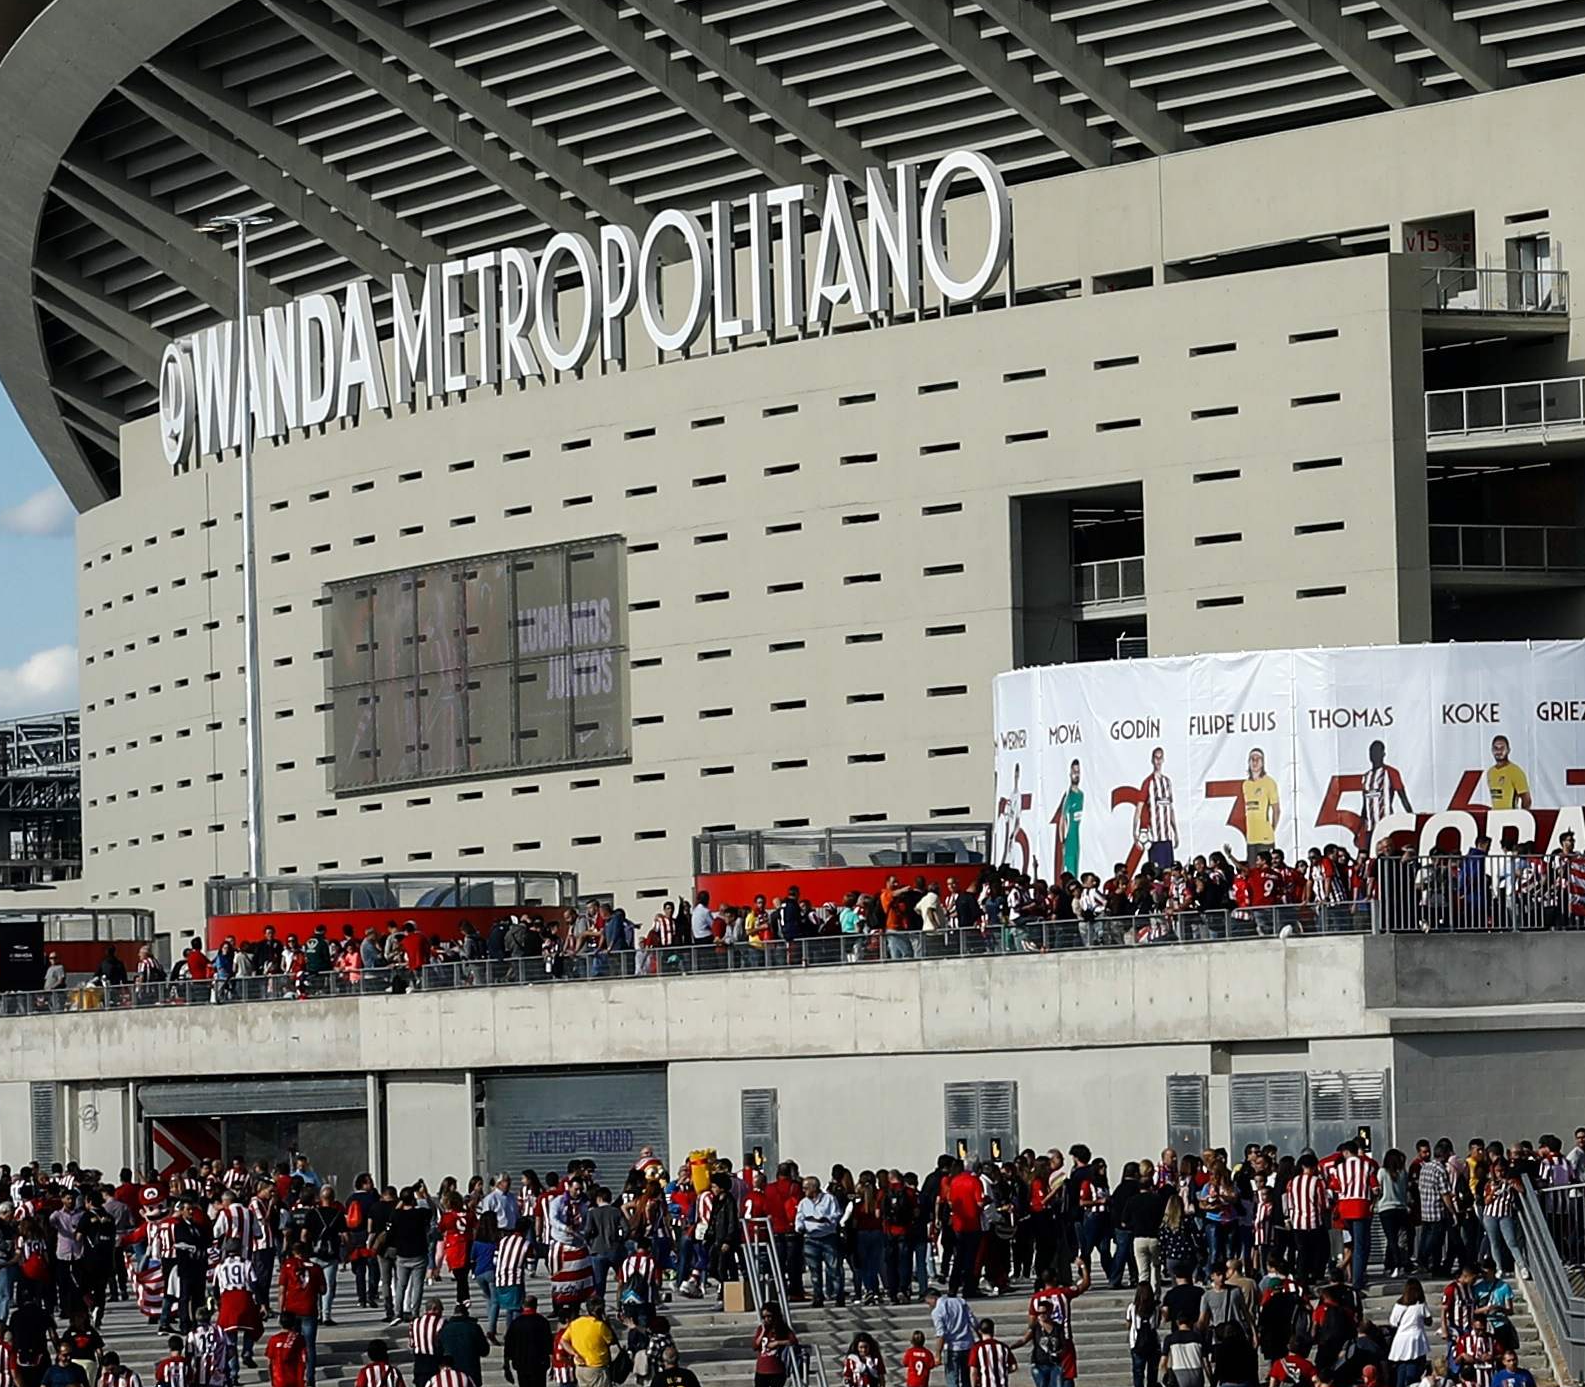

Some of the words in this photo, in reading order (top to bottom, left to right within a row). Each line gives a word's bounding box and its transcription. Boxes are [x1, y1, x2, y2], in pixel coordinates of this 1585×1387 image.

[1407, 229, 1440, 253] v15
[191, 281, 389, 456] WANDA
[392, 151, 1011, 409] METROPOLITANO
[518, 597, 611, 653] LUCHAMOS
[1189, 714, 1234, 736] FILIPE
[1241, 712, 1276, 732] LUIS
[1309, 706, 1394, 729] THOMAS
[1442, 703, 1500, 724] KOKE
[1049, 720, 1082, 745] MOYÁ
[1110, 715, 1160, 740] GODÍN
[529, 1129, 577, 1153] ATLÉTICO
[589, 1128, 633, 1152] MADRID
[223, 1265, 242, 1285] 19
[915, 1360, 924, 1376] 9
